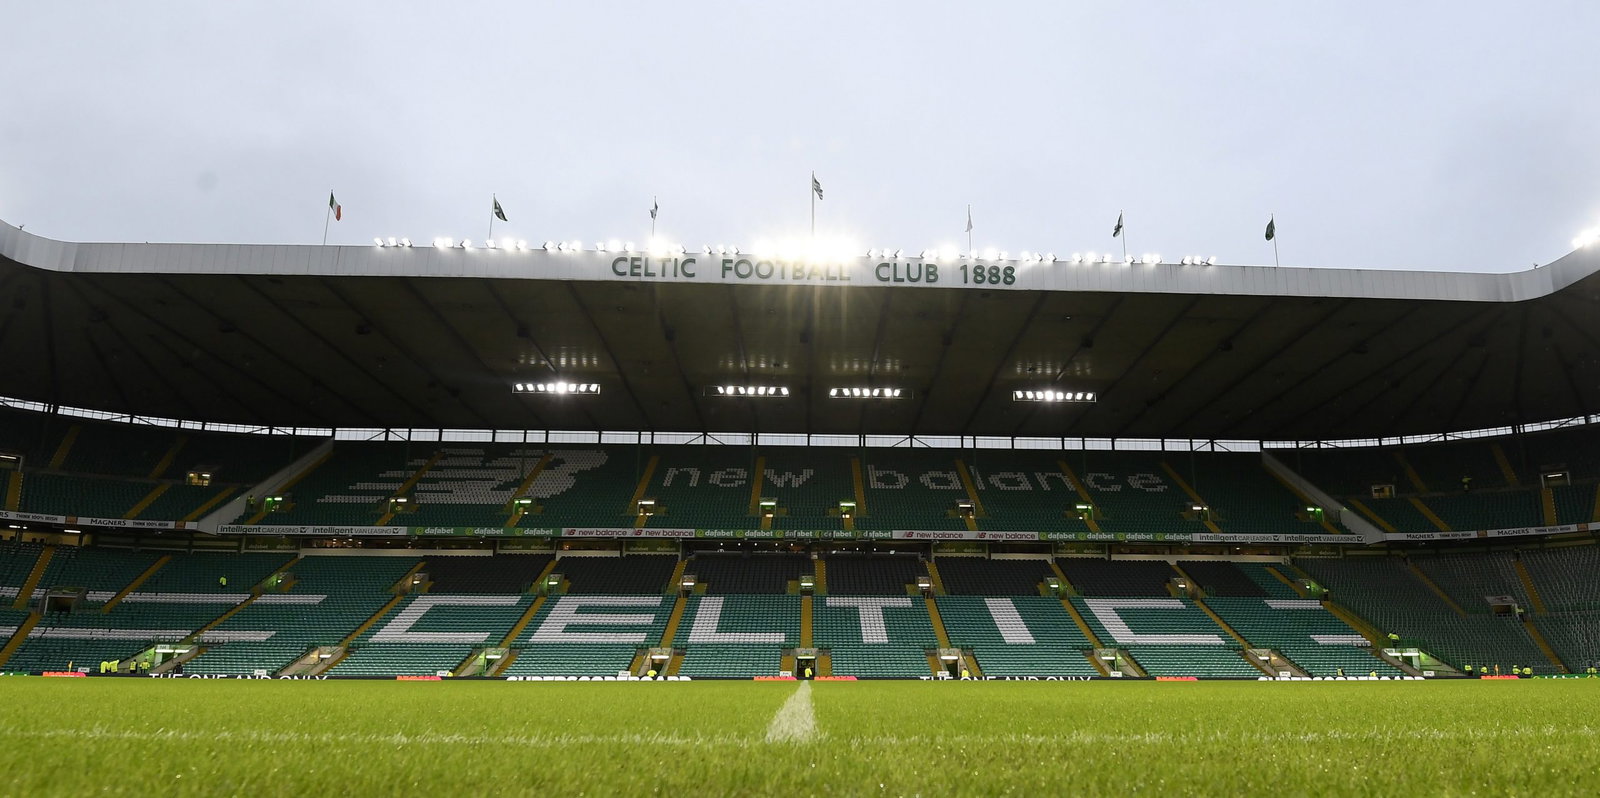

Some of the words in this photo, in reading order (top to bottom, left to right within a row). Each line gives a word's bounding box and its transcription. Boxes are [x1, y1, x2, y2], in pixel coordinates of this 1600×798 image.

[612, 256, 697, 278] CELTIC
[721, 258, 851, 281] FOOTBALL
[875, 262, 939, 283] CLUB
[960, 264, 1017, 285] 1888
[663, 467, 814, 488] new
[867, 464, 1168, 492] balance
[90, 518, 127, 527] MAGNERS
[220, 525, 261, 533] intelligent
[312, 526, 353, 535] intelligent
[425, 527, 454, 535] dafabet
[474, 527, 503, 535] dafabet
[524, 528, 553, 536] dafabet
[704, 529, 733, 537] dafabet
[744, 529, 773, 537] dafabet
[1497, 528, 1530, 536] MAGNERS
[932, 531, 964, 539] balance
[1005, 532, 1036, 540] balance
[1048, 532, 1075, 540] dafabet
[1087, 532, 1114, 540] dafabet
[1126, 532, 1153, 540] dafabet
[1165, 532, 1192, 540] dafabet
[1199, 534, 1237, 542] intelligent
[1284, 535, 1322, 543] intelligent
[367, 595, 1226, 645] CELTIC
